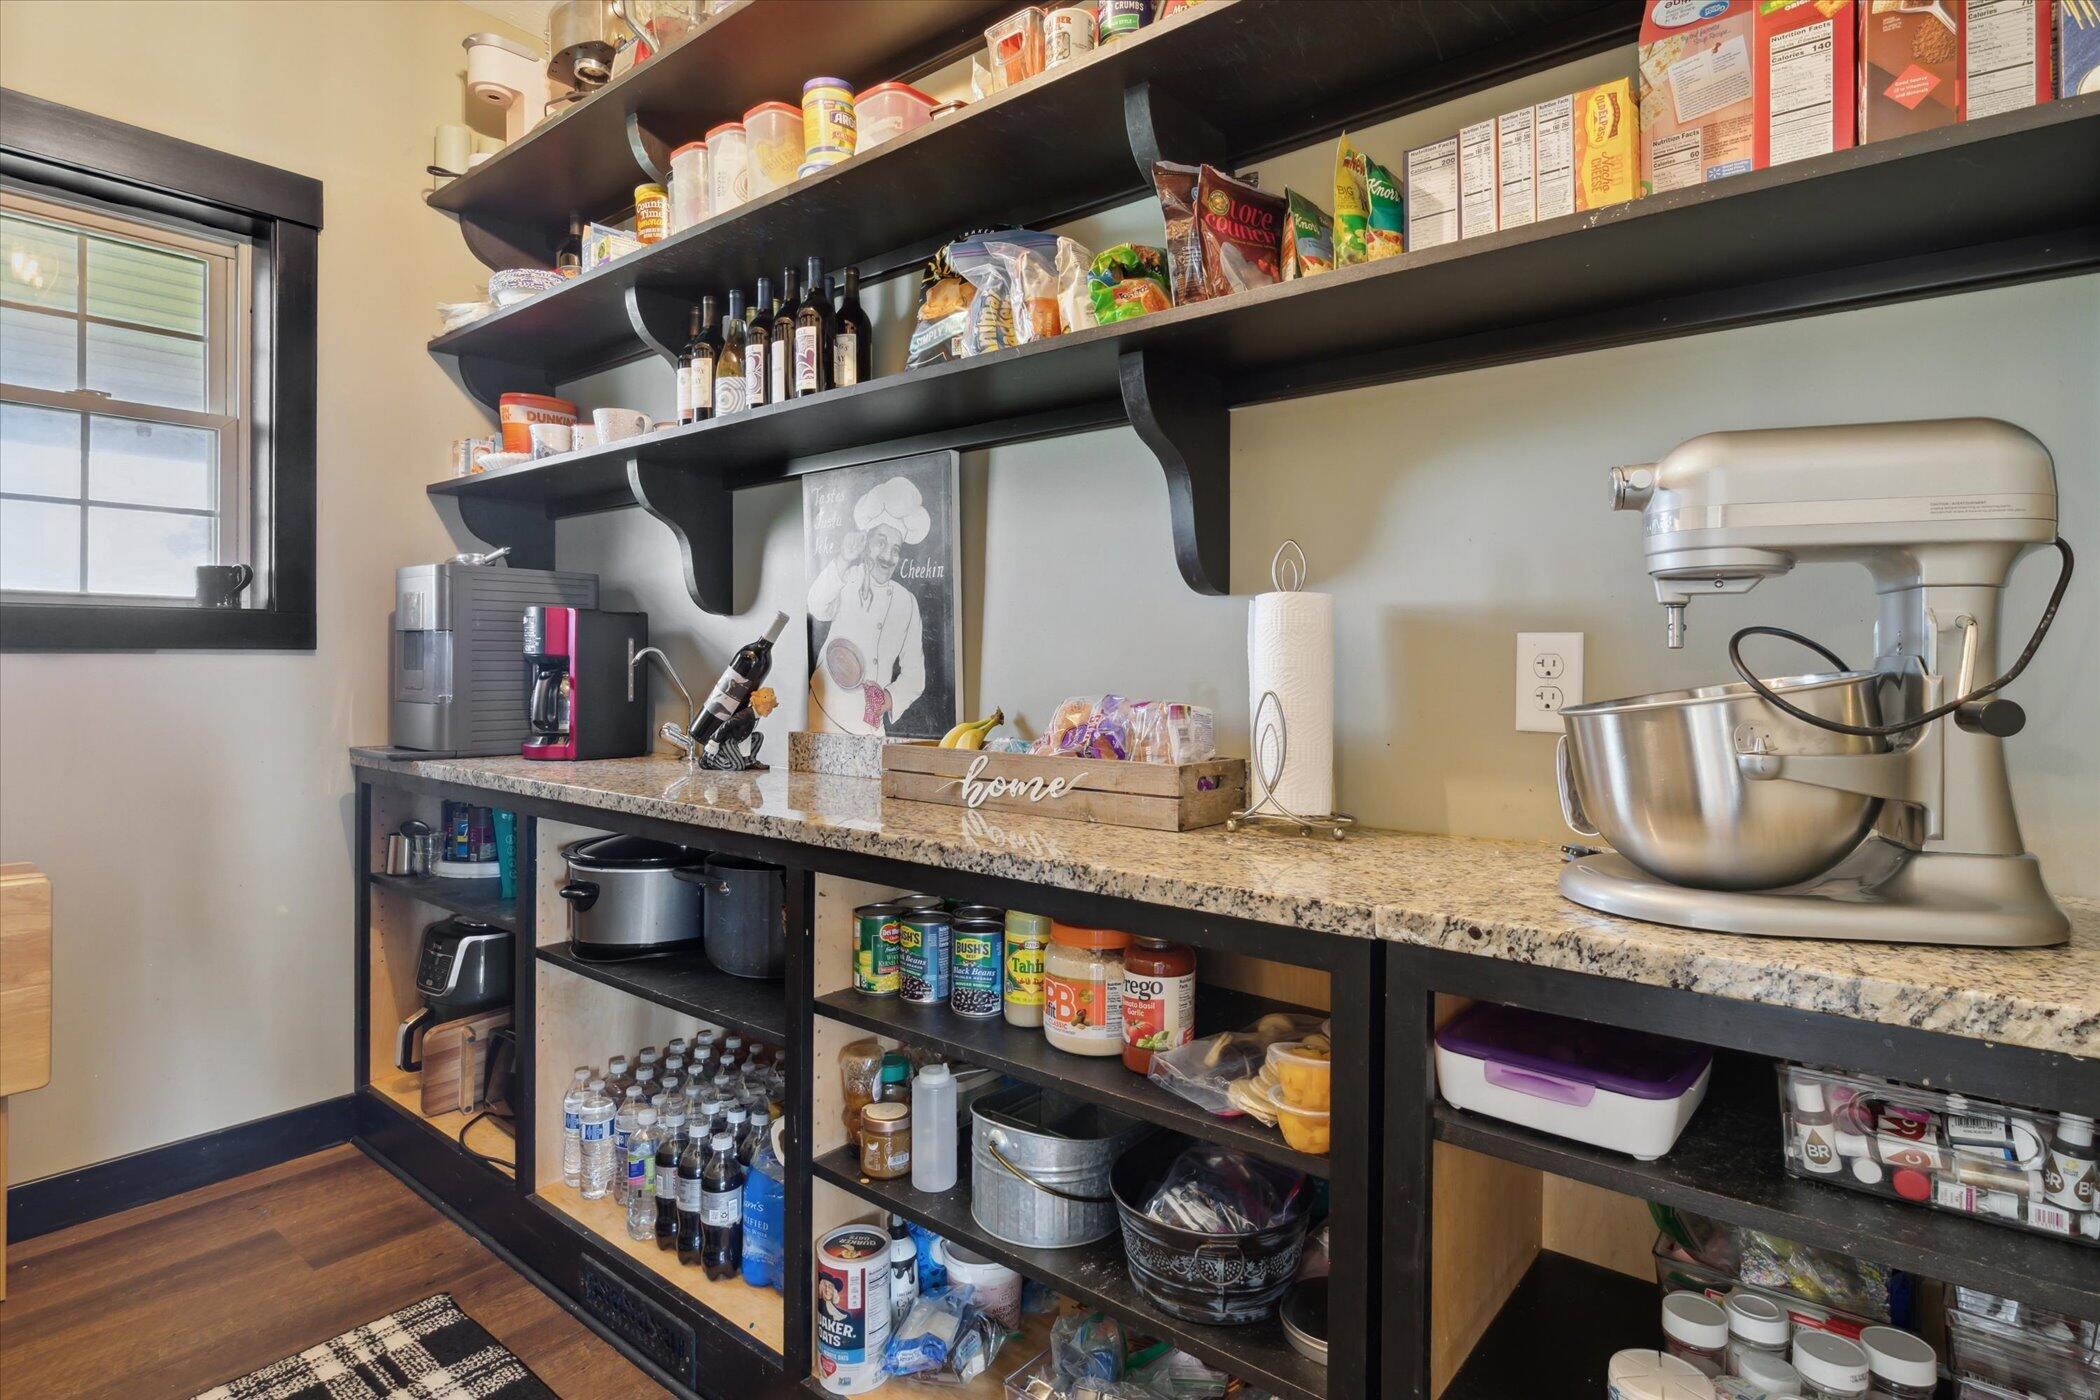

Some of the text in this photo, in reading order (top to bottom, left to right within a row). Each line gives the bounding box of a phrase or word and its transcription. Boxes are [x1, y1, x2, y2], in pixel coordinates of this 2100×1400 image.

[1771, 21, 1832, 43] Nutrition Facts
[1771, 41, 1832, 64] Calories 140
[1653, 129, 1700, 147] Nutrition Facts
[1441, 157, 1456, 168] 200
[1653, 150, 1700, 169] Calories 60
[1590, 157, 1602, 194] CHEESE
[1337, 185, 1355, 197] BIG
[1367, 178, 1401, 202] Knorr
[900, 558, 945, 581] Cheekin
[936, 754, 1089, 808] home
[956, 941, 989, 955] BUSH'S
[971, 967, 997, 977] Beans
[1124, 978, 1164, 1002] rego
[1127, 1008, 1145, 1016] Garlic
[1138, 1001, 1156, 1009] Basil
[1807, 1144, 1830, 1158] BR
